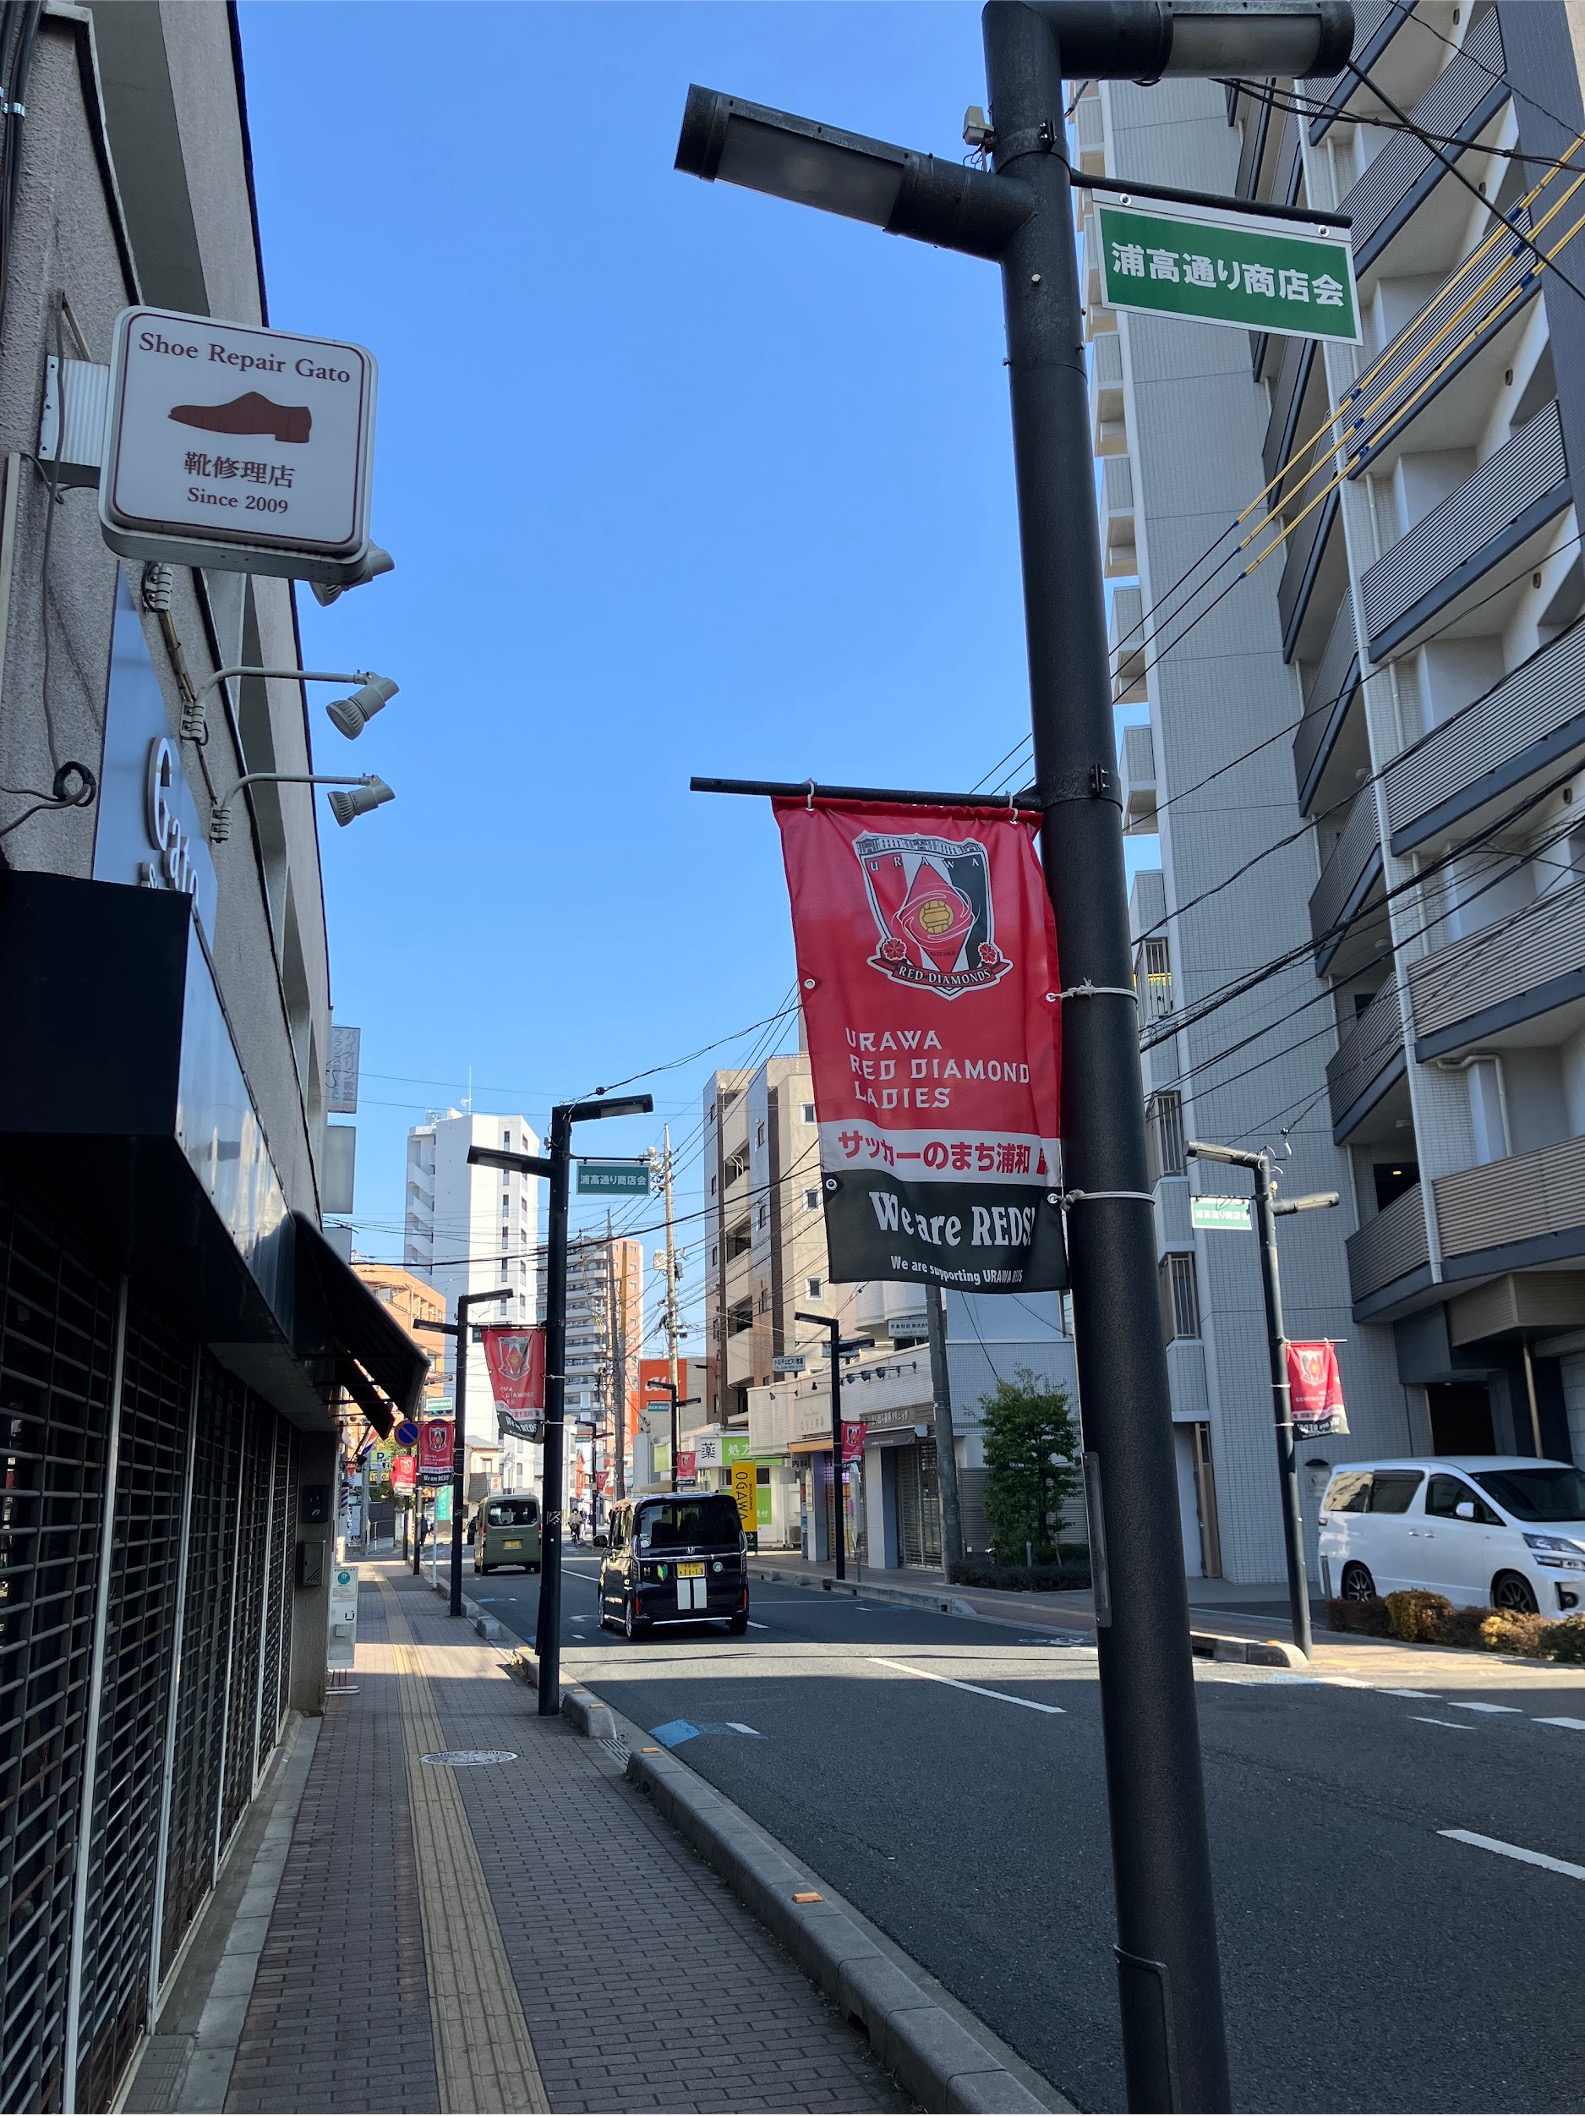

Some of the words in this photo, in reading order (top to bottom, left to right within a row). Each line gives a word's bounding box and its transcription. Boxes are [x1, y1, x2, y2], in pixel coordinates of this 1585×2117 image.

[1111, 241, 1344, 307] 浦高通り商店会
[139, 332, 198, 359] Shoe
[208, 343, 286, 373] Repair
[295, 358, 351, 383] Gato
[183, 451, 295, 489] 靴修理店
[187, 488, 238, 508] Since
[245, 495, 288, 514] 2009
[869, 856, 980, 872] URAWA
[898, 966, 923, 980] RED
[928, 968, 991, 985] DIAMONDS
[845, 1027, 942, 1052] URAWA
[849, 1053, 896, 1080] RED
[854, 1081, 951, 1109] LADIES
[838, 1130, 1031, 1175] サッカーのまち浦和
[580, 1174, 647, 1186] 浦高通り商店会
[869, 1191, 914, 1235] We
[915, 1213, 961, 1247] are
[971, 1206, 1036, 1247] REDS!
[891, 1255, 908, 1270] We
[911, 1261, 928, 1273] are
[929, 1265, 981, 1286] supporting
[982, 1269, 1011, 1283] URAWA
[701, 1442, 716, 1459] 薬
[792, 1460, 807, 1468] 内科
[735, 1471, 748, 1521] OGAWA
